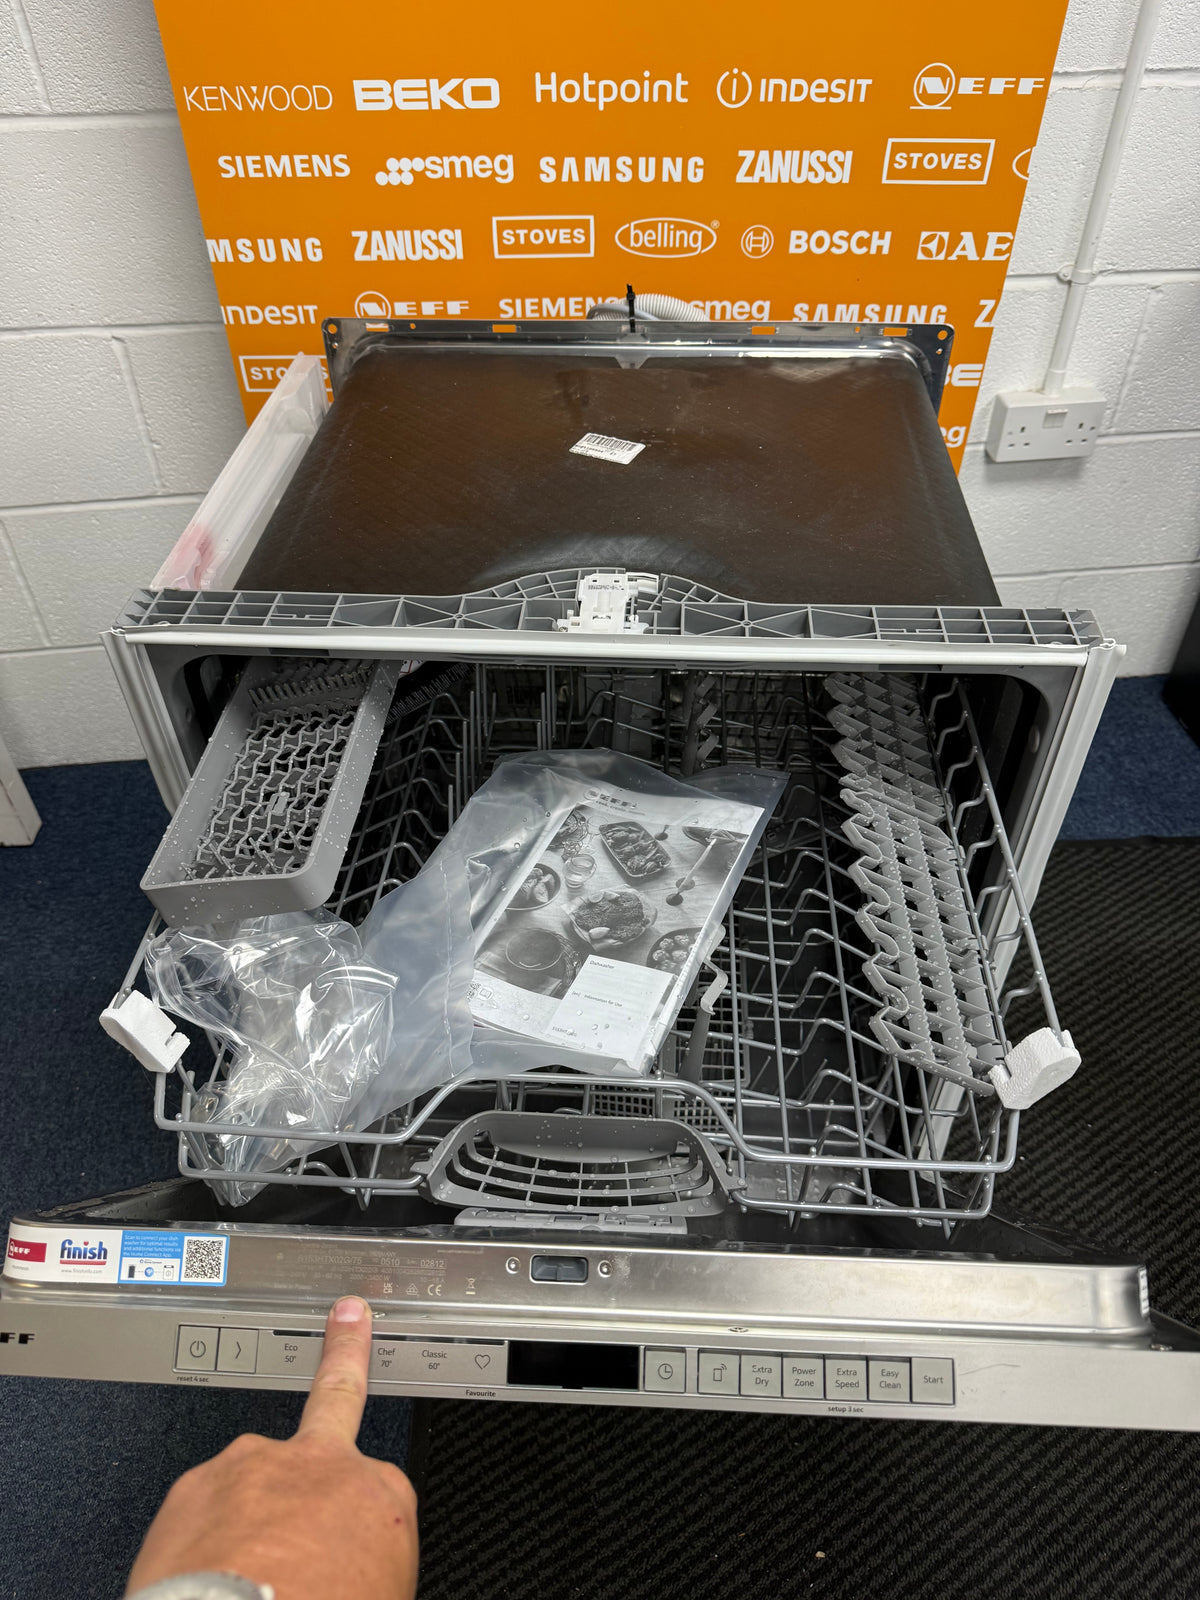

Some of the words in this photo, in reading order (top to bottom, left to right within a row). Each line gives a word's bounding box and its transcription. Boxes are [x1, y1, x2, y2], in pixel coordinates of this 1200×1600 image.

[353, 78, 500, 111] BEKO
[535, 71, 688, 110] Hotpoint
[183, 85, 333, 111] KENWOOD
[218, 154, 351, 179] SIEMENS
[894, 152, 982, 170] STOVES
[425, 155, 514, 183] smeg
[540, 156, 704, 183] SAMSUNG
[736, 150, 853, 184] ZANUSSI
[503, 228, 586, 245] STOVES
[630, 222, 702, 253] belling
[352, 229, 464, 261] ZANUSSI
[789, 230, 892, 255] BOSCH
[792, 303, 948, 324] SAMSUNG
[251, 366, 329, 381] STOS
[9, 1243, 31, 1255] NEFF
[60, 1239, 108, 1260] finish
[380, 1256, 400, 1268] 0510
[420, 1259, 445, 1269] 02812
[284, 1343, 298, 1352] Eco
[377, 1347, 396, 1357] Chef
[284, 1355, 297, 1363] 50°
[421, 1349, 448, 1359] Classic
[381, 1359, 393, 1368] 70°
[428, 1362, 441, 1370] 60°
[752, 1364, 773, 1374] Extra
[792, 1366, 817, 1375] Power
[836, 1367, 858, 1376] Extra
[880, 1368, 900, 1379] Easy
[755, 1377, 770, 1388] Dry
[794, 1378, 815, 1388] Zone
[835, 1380, 860, 1389] Speed
[879, 1380, 902, 1389] Clean
[923, 1375, 944, 1384] Start
[465, 1389, 496, 1398] Favourite
[827, 1406, 847, 1414] setup
